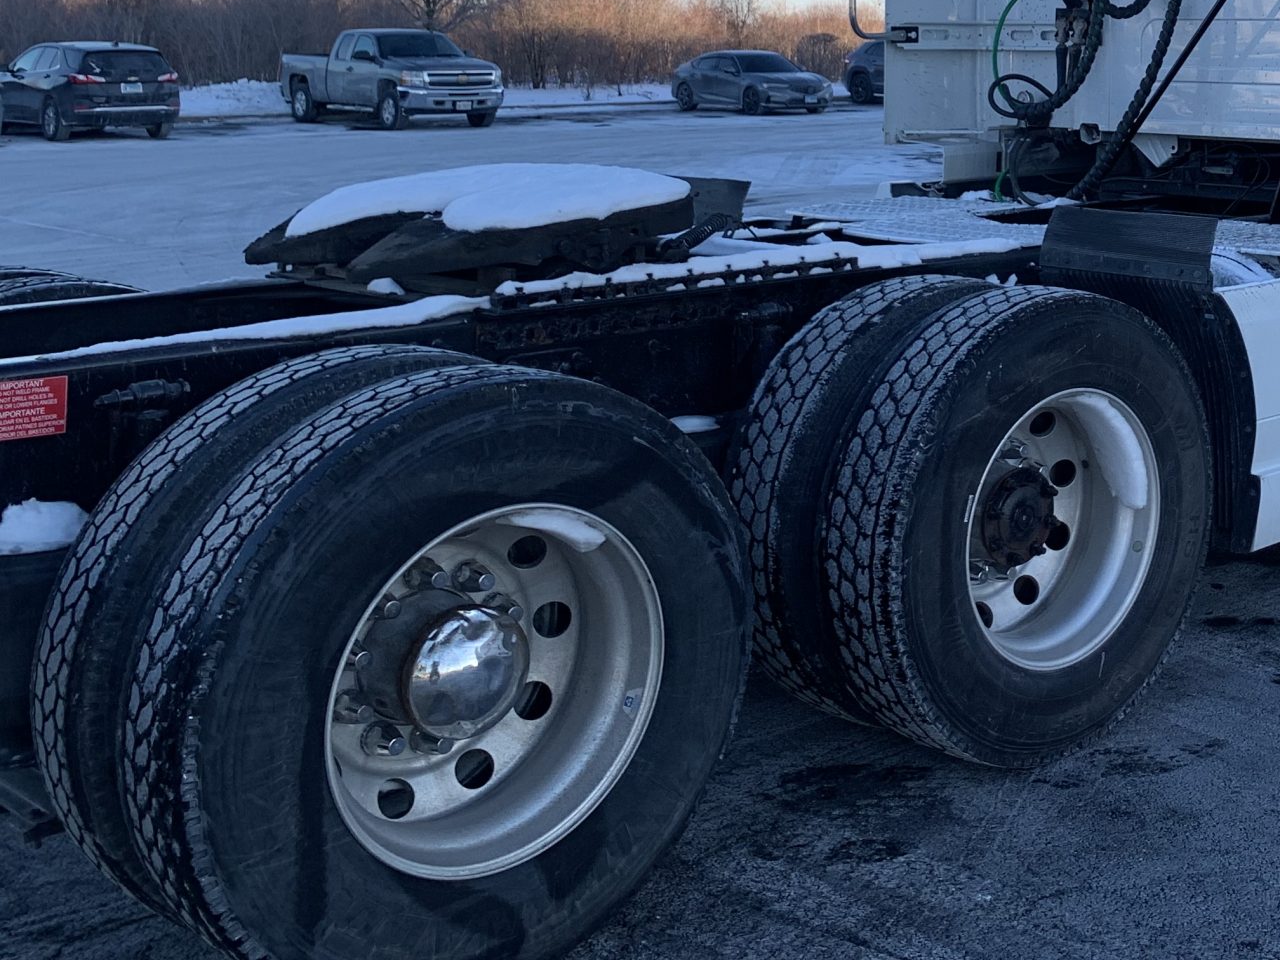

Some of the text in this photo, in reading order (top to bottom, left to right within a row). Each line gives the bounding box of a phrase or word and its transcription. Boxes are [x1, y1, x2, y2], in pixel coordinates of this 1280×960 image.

[0, 379, 44, 390] IMPORTANT
[13, 401, 33, 409] LOWER
[0, 407, 46, 418] MPORTANTE
